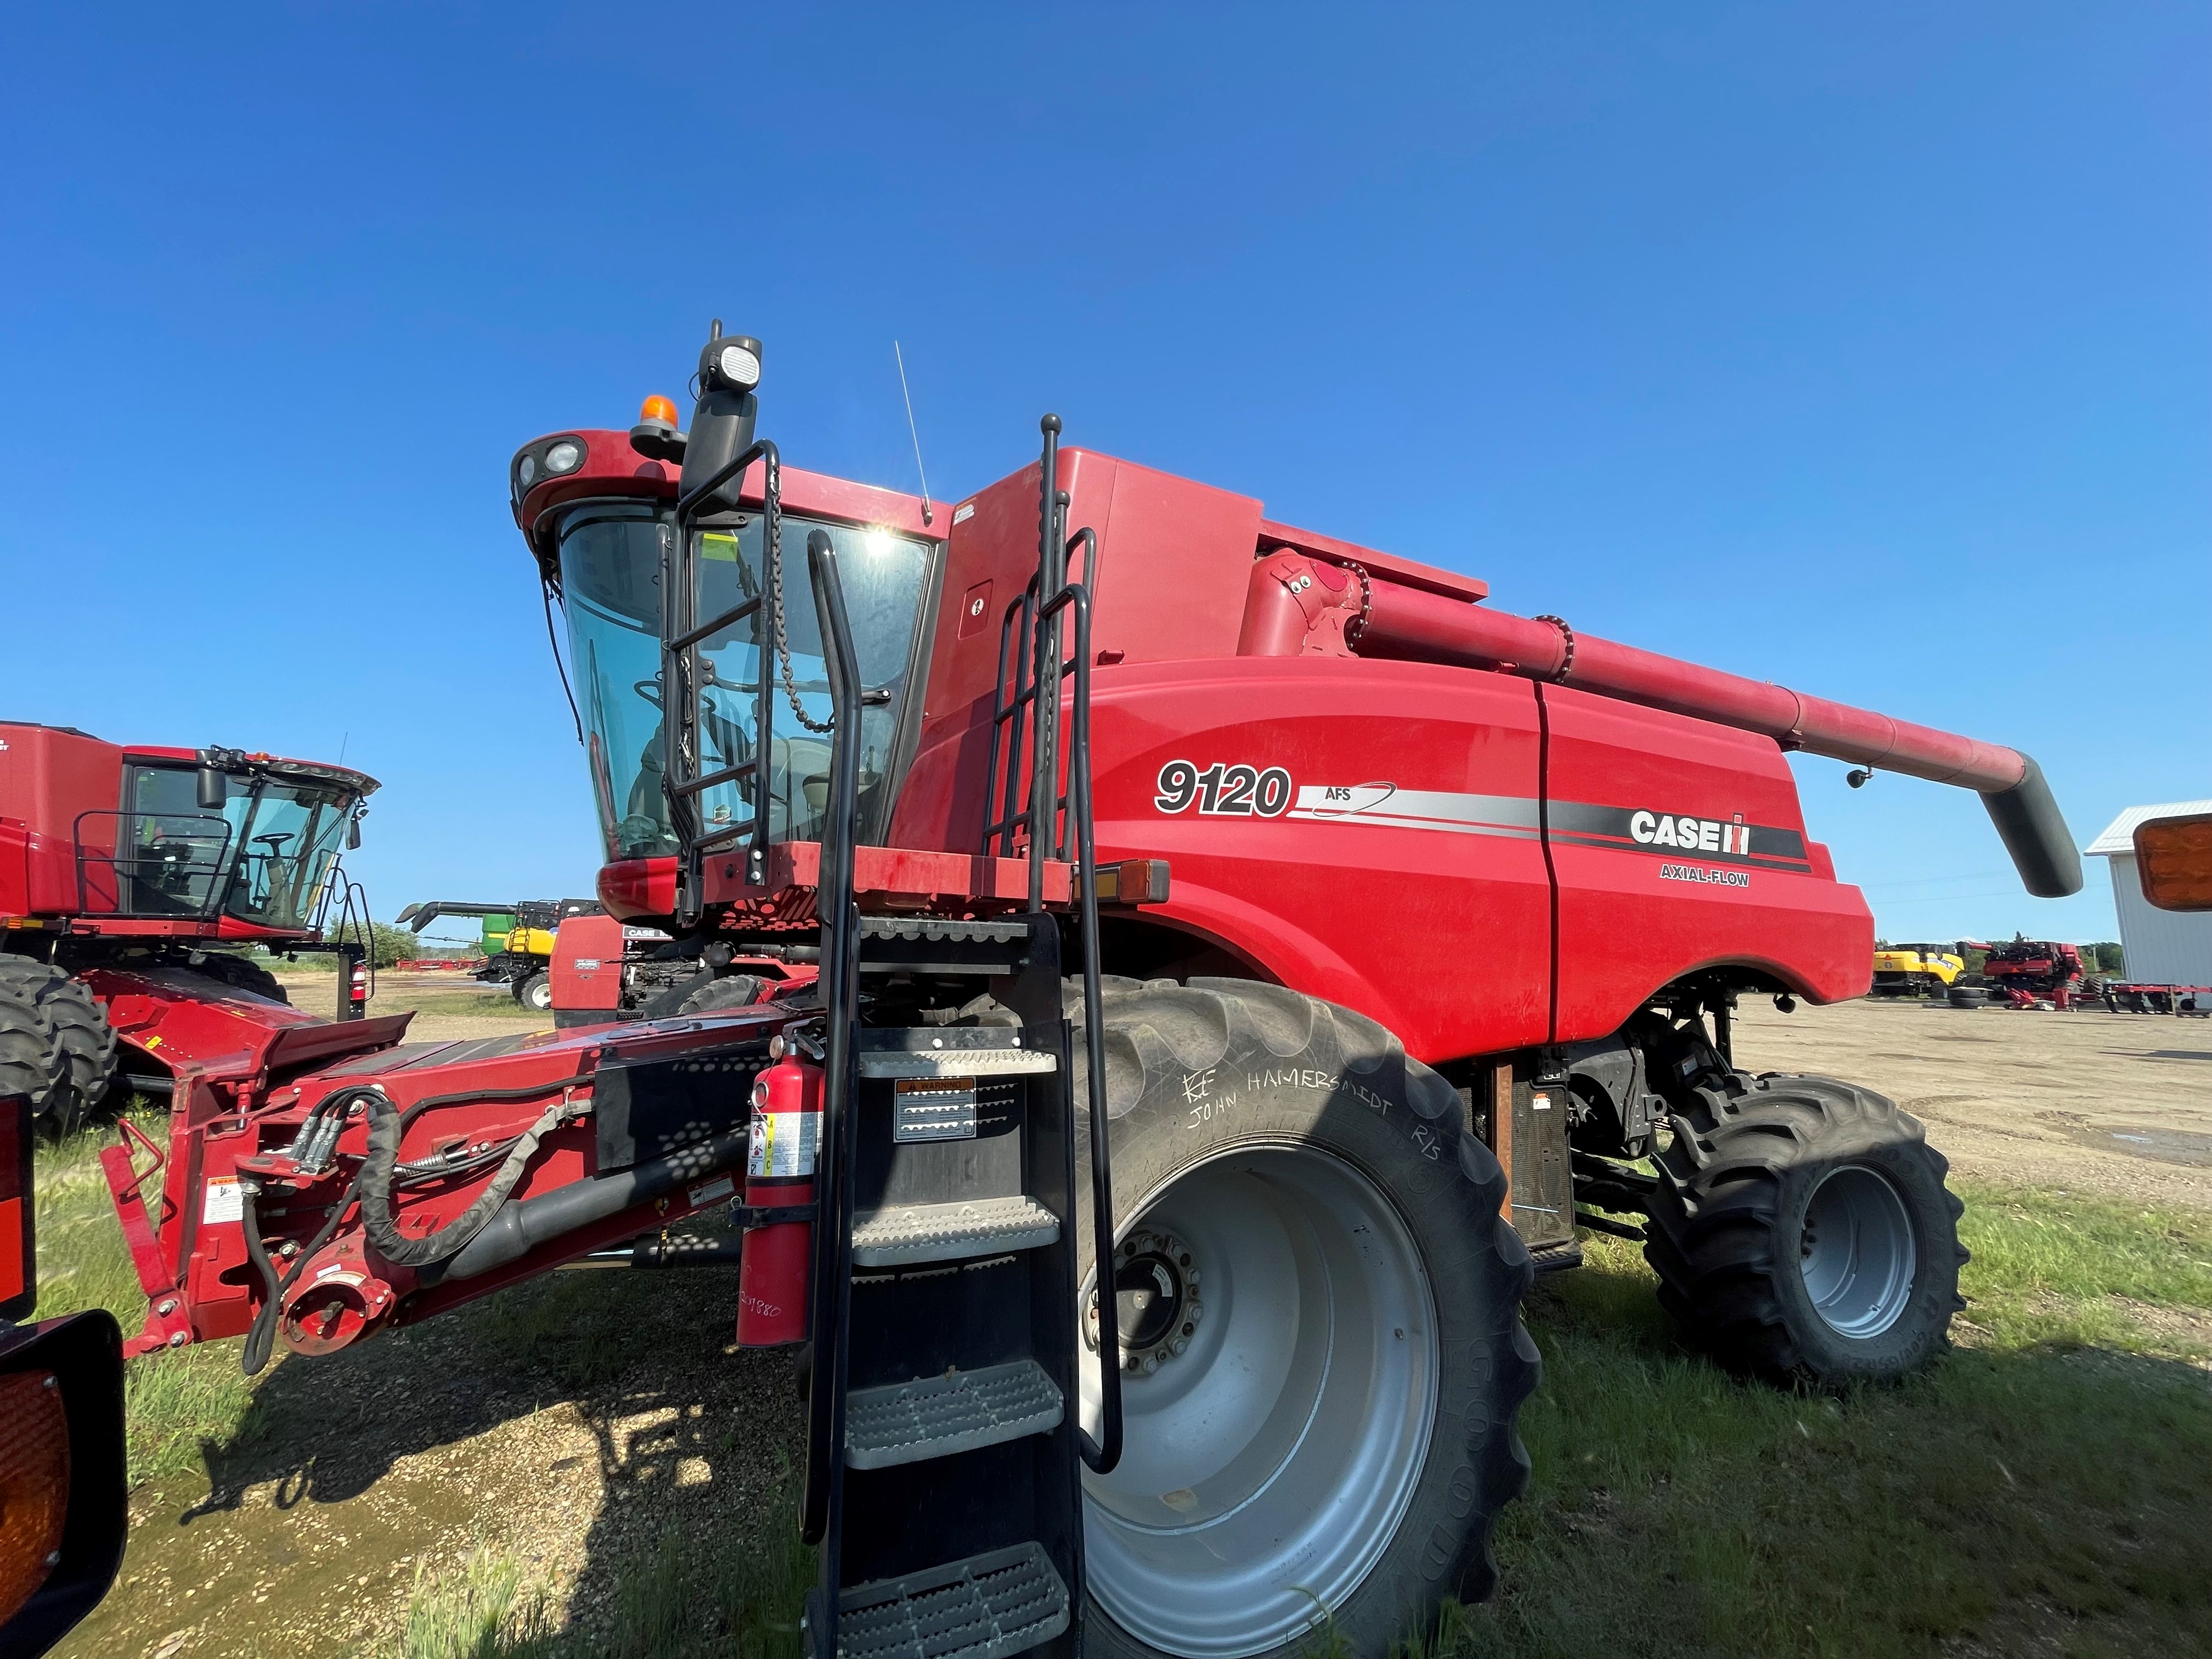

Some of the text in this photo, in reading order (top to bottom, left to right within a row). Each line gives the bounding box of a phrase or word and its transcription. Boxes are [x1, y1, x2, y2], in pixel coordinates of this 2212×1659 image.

[1155, 760, 1291, 816] 9120
[1324, 787, 1351, 801] AFS
[1631, 811, 1720, 851] CASE
[1660, 864, 1749, 887] AXIAL-FLOW
[921, 1081, 962, 1090] WARNING
[1188, 1092, 1237, 1129] JOHN
[769, 1120, 773, 1128] A
[768, 1140, 772, 1149] B
[766, 1160, 771, 1169] C
